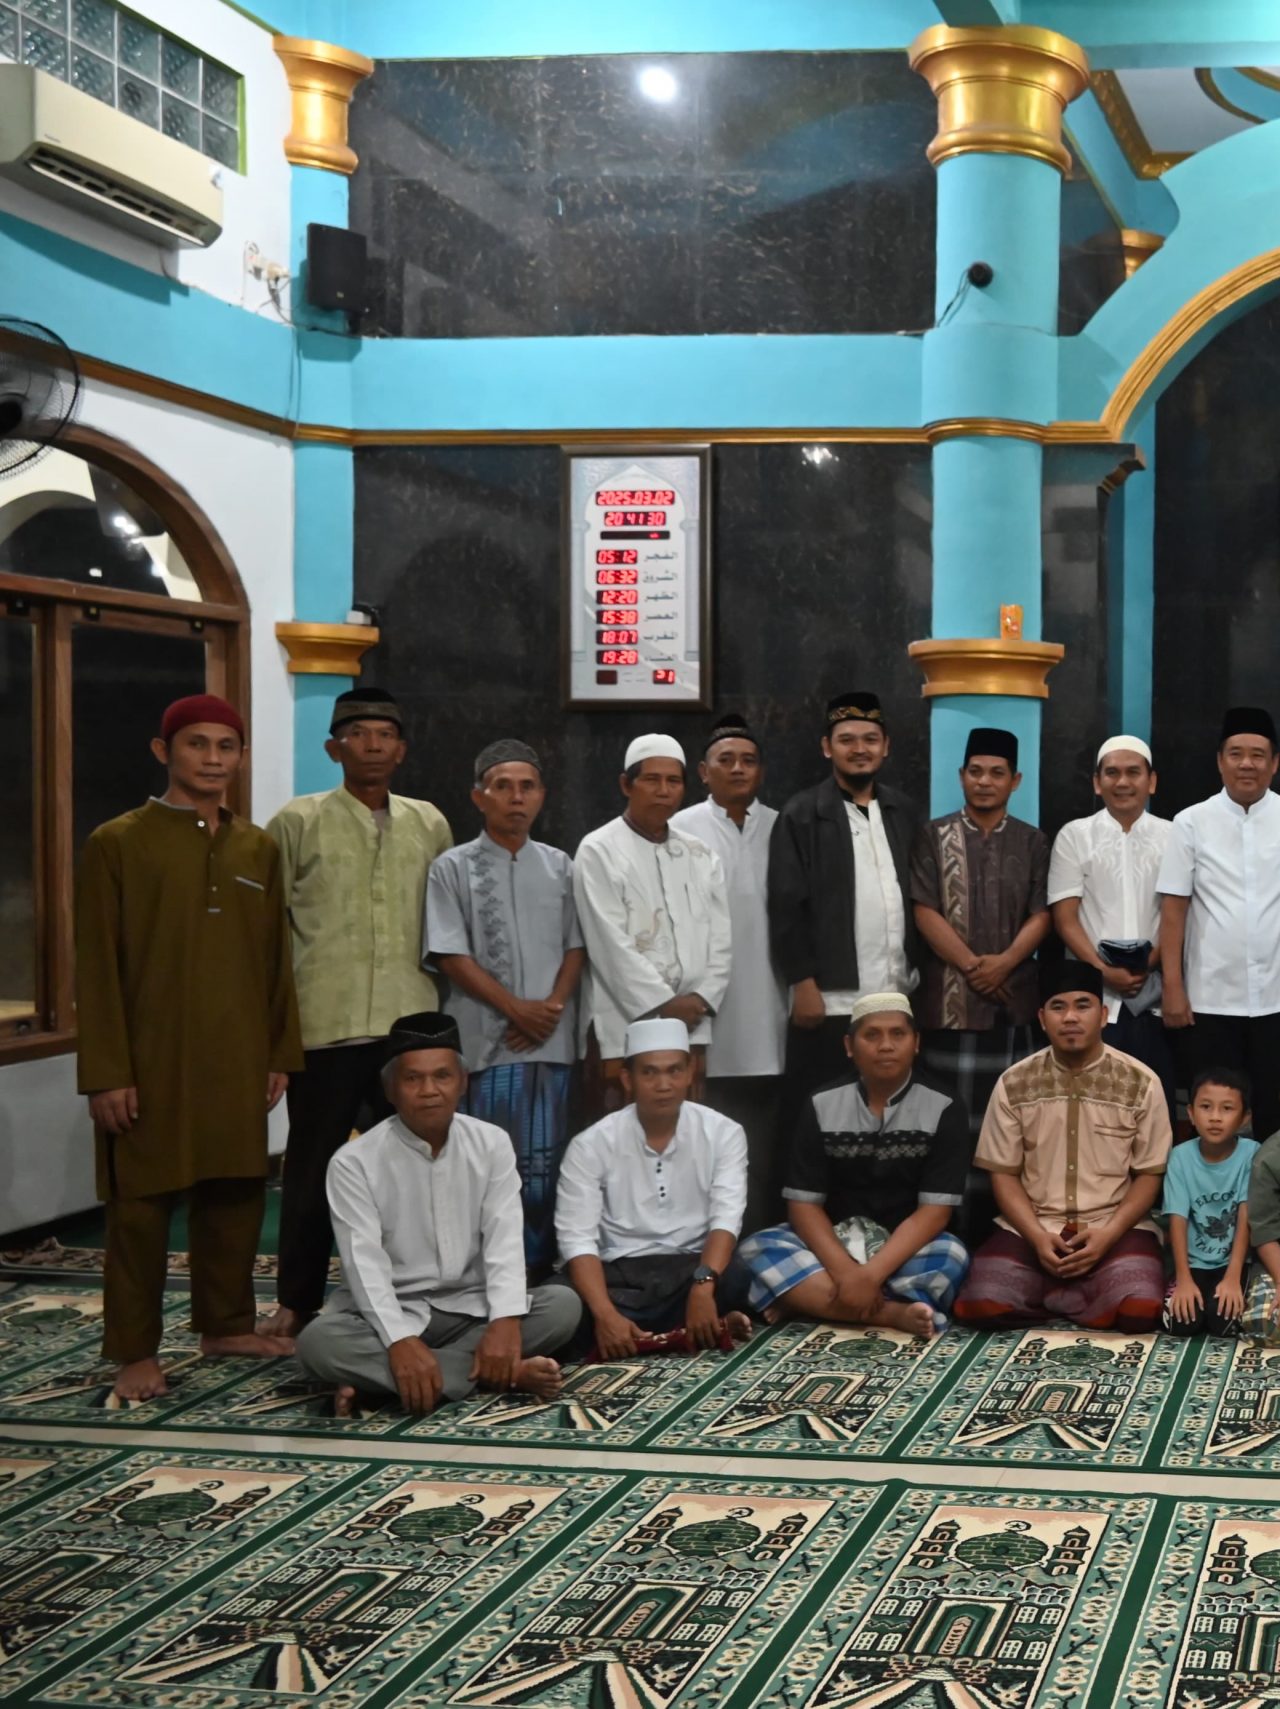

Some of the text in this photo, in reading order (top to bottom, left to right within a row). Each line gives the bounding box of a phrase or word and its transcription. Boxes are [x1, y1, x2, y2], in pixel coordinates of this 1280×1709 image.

[598, 570, 636, 584] 06:32
[602, 590, 636, 604] 12:20
[602, 610, 636, 624] 15:38
[602, 630, 637, 644] 18:07
[602, 650, 637, 664] 19:28
[1193, 1190, 1237, 1208] ELCO
